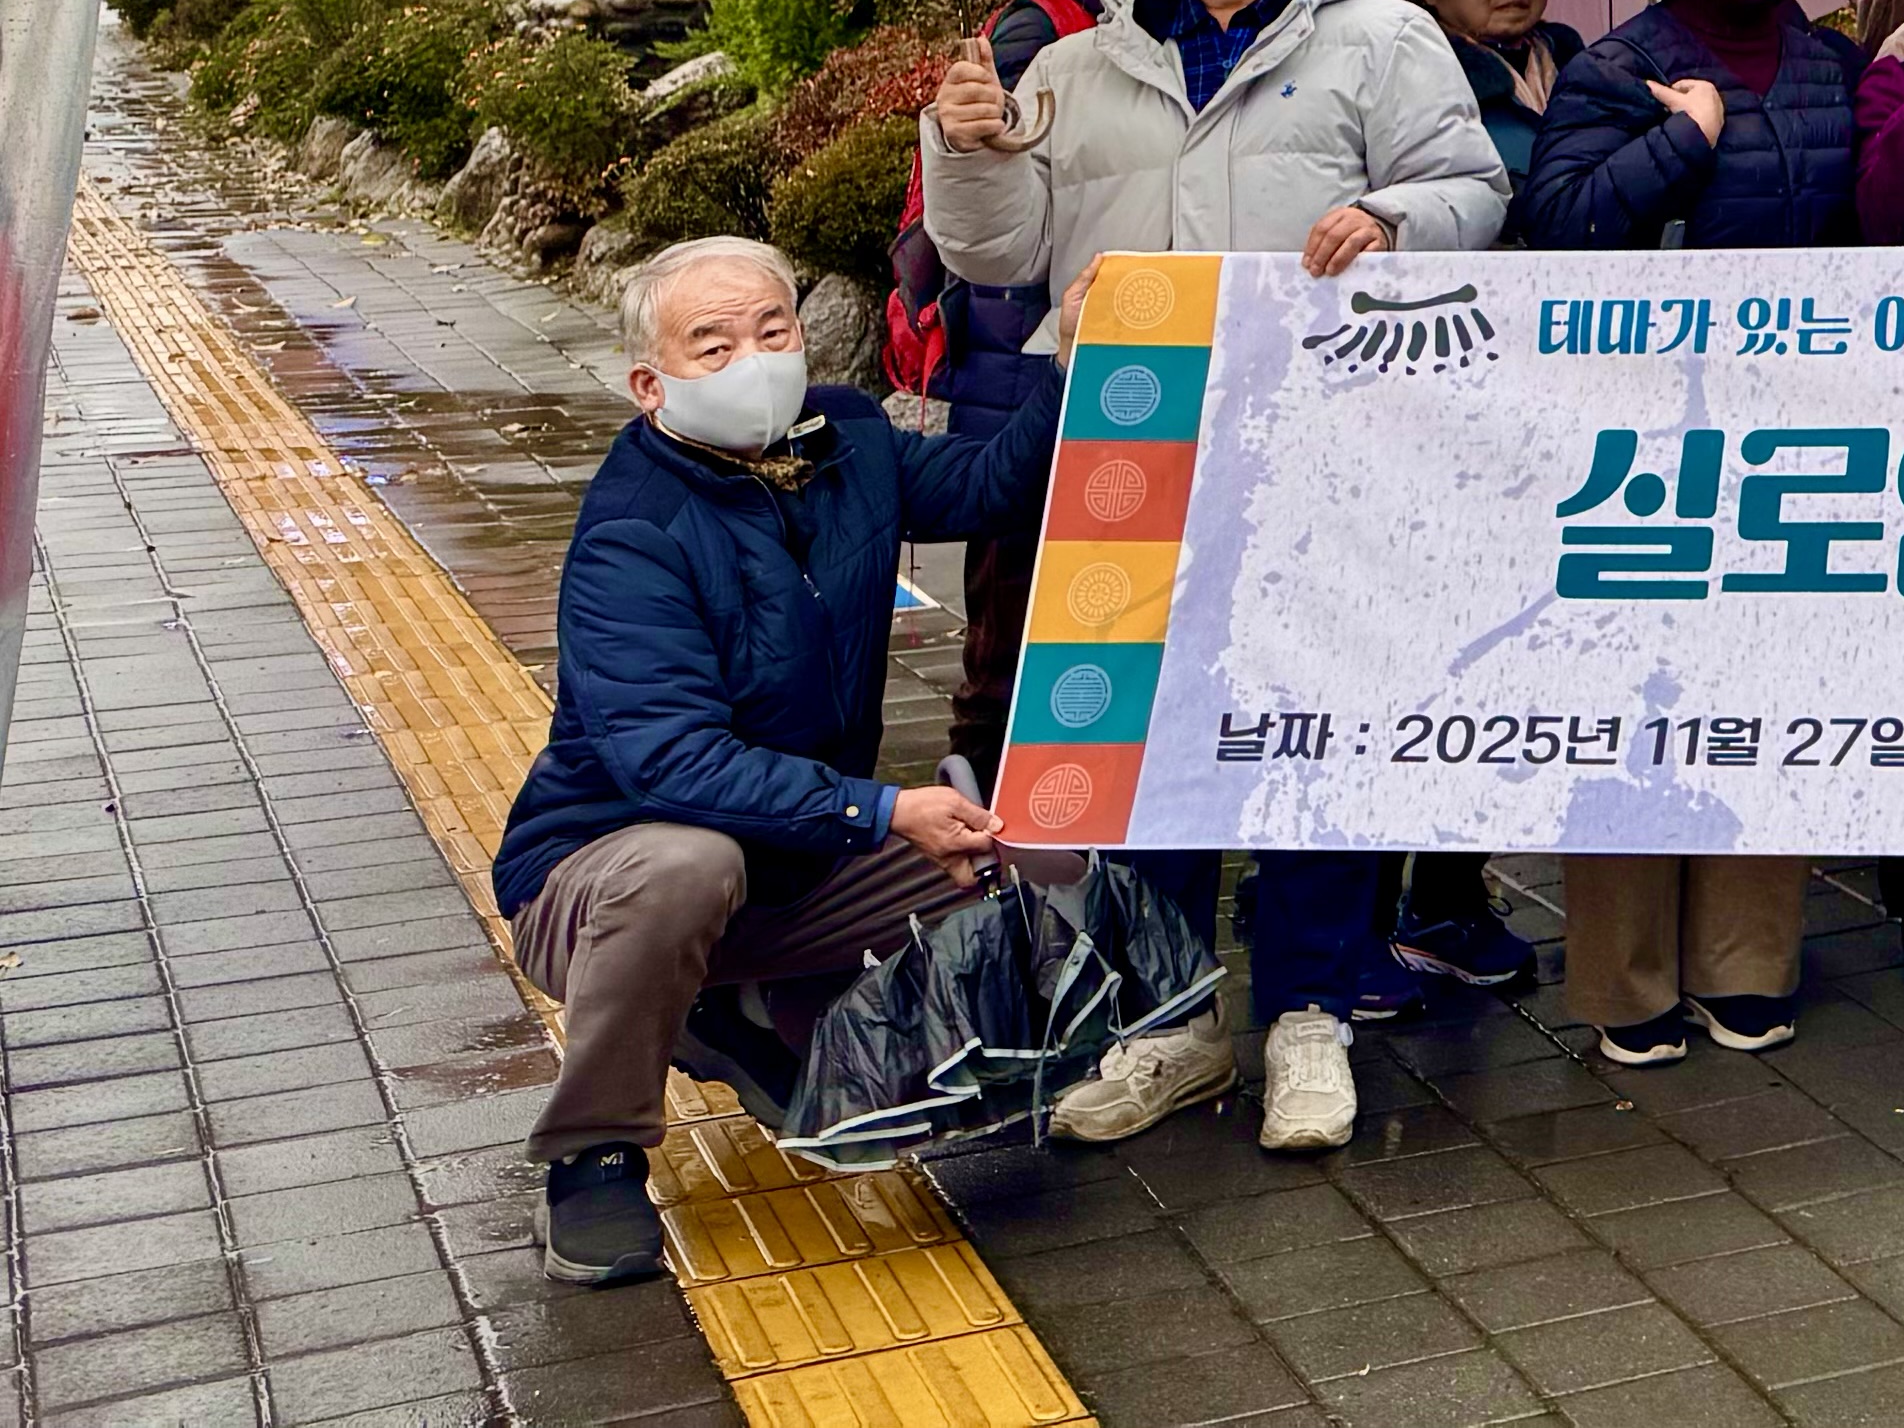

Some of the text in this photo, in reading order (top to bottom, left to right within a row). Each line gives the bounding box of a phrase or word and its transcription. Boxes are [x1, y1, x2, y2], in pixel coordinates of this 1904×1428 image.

[1538, 298, 1718, 355] 테마가
[1735, 297, 1853, 356] 있는
[1216, 712, 1334, 762] 날짜
[1390, 714, 1622, 765] 2025년
[1644, 717, 1762, 767] 11월
